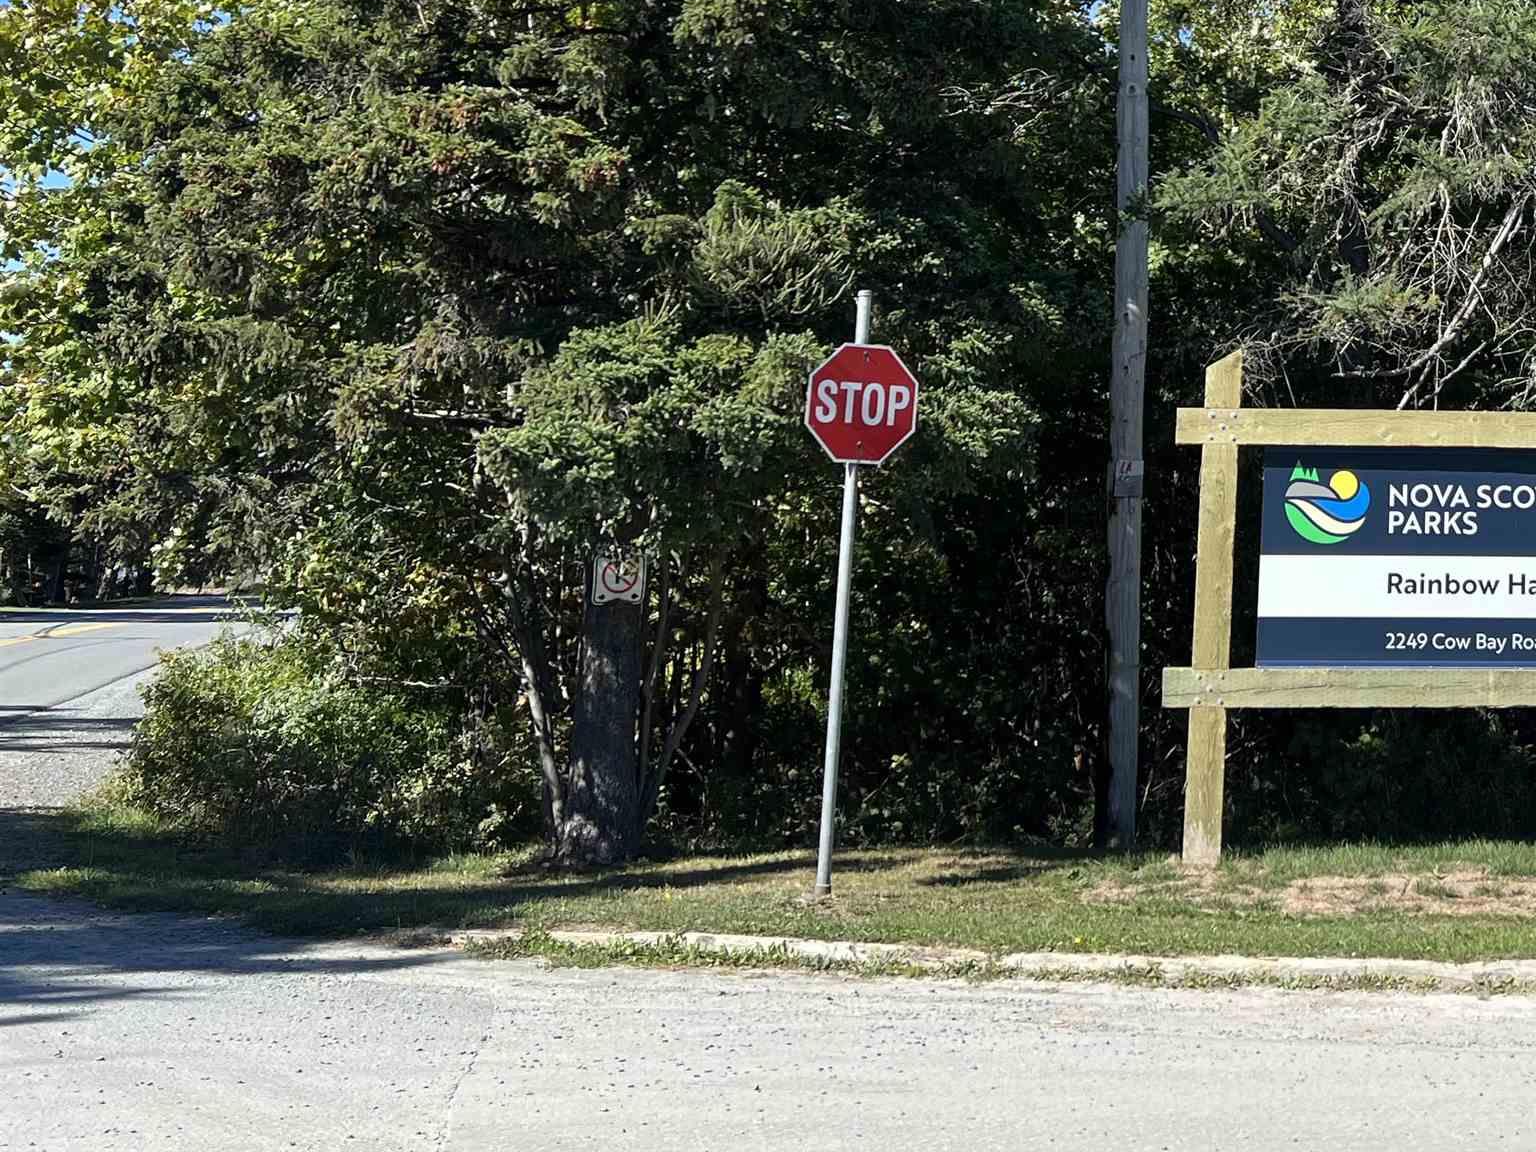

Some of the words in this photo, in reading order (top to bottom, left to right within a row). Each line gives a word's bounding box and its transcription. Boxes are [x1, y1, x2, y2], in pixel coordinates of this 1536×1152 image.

[815, 378, 911, 427] STOP
[1388, 483, 1470, 508] NOVA
[1387, 510, 1478, 536] PARKS
[1386, 572, 1500, 595] Rainbow
[1384, 632, 1428, 650] 2249
[1431, 632, 1471, 650] Cow
[1475, 633, 1508, 654] Bay
